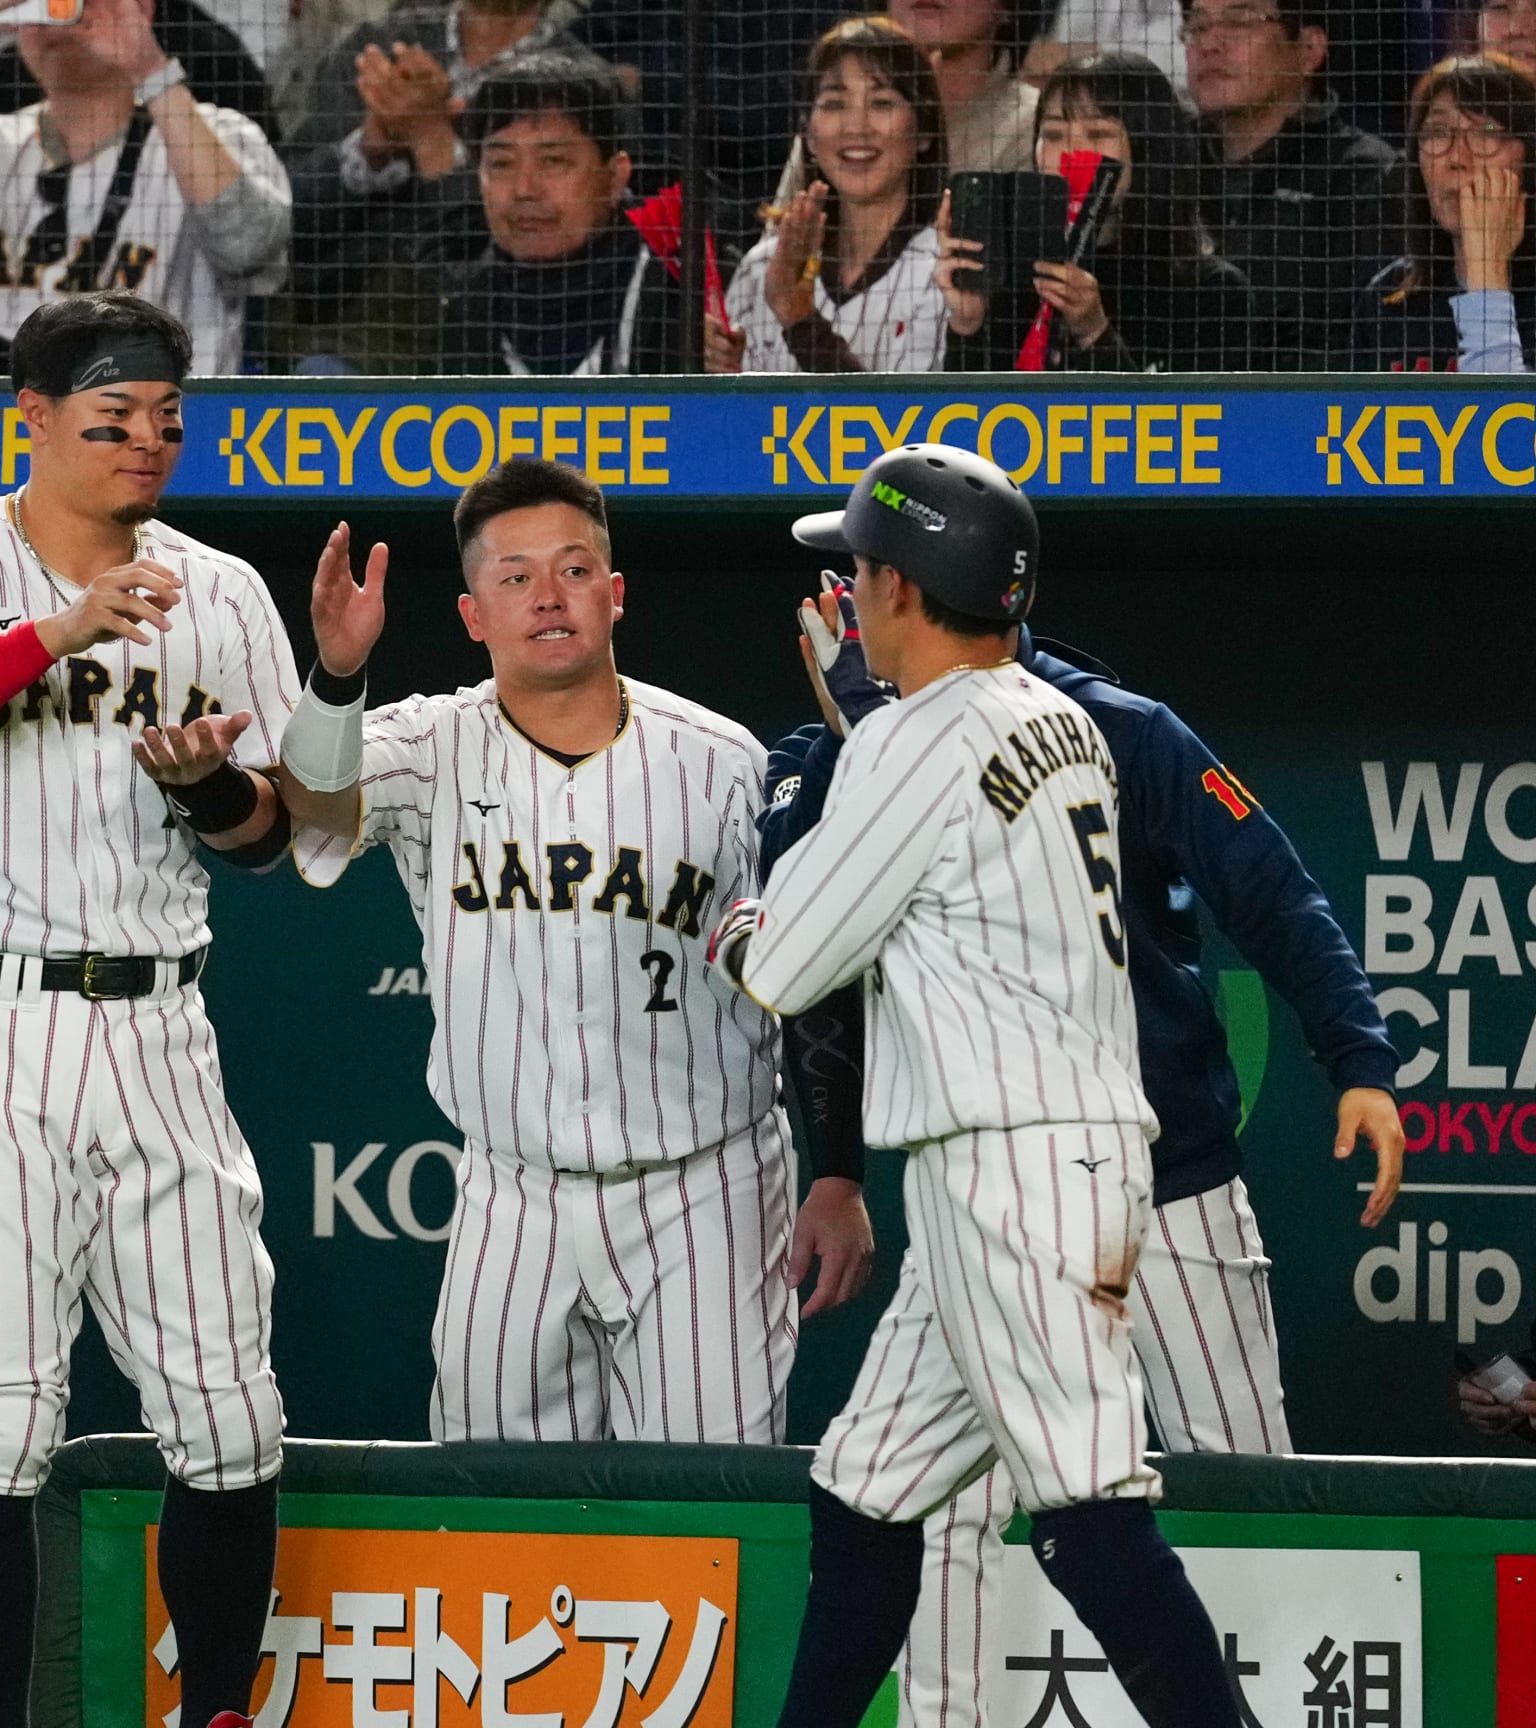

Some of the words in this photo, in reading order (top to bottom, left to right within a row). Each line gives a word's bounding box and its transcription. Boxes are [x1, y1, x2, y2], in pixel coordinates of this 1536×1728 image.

[1013, 550, 1028, 575] 5
[1201, 763, 1264, 821] 1
[451, 840, 715, 940] JAPAN
[1065, 798, 1127, 970] 5
[1364, 874, 1536, 977] BA
[639, 950, 679, 1012] 2
[1353, 1220, 1522, 1344] dip
[1042, 1538, 1057, 1561] 5
[152, 1585, 727, 1728] ケモトピアノ
